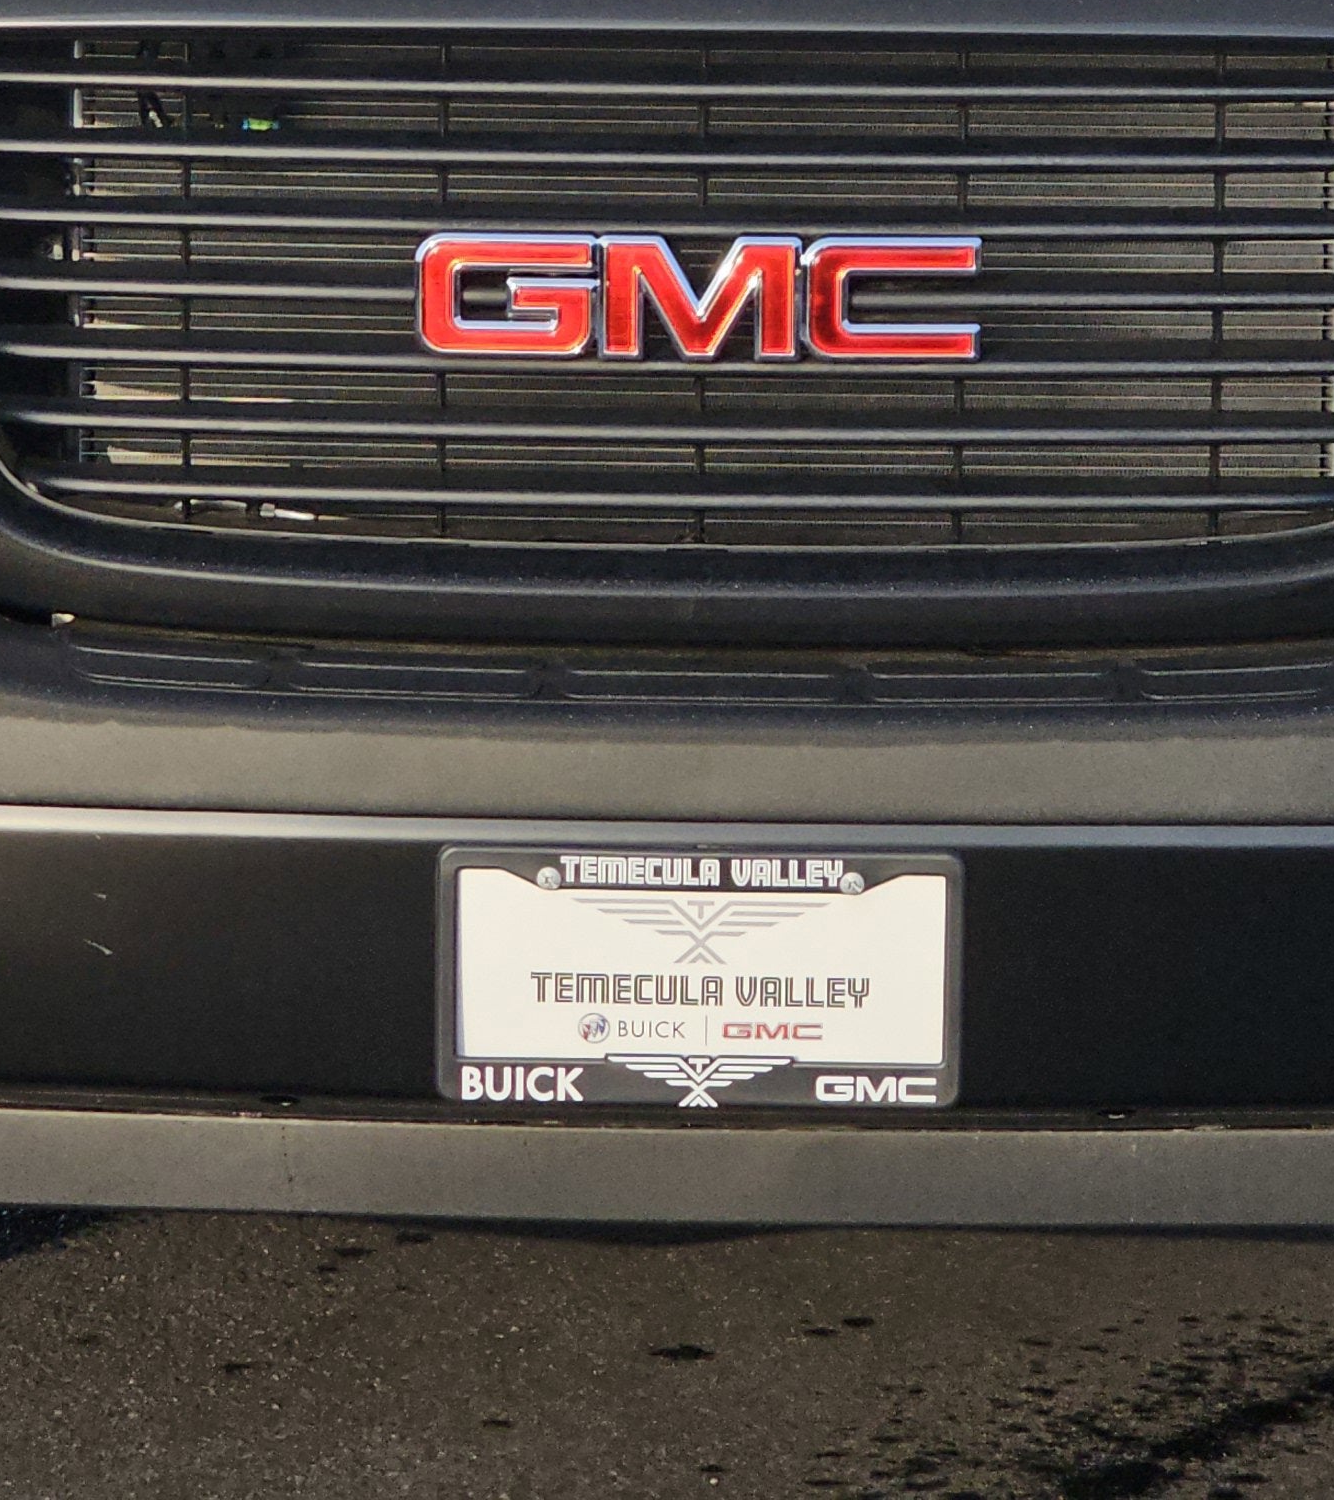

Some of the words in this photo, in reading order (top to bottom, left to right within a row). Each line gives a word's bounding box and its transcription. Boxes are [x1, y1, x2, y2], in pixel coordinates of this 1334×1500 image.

[415, 231, 982, 362] GMC
[560, 854, 721, 886] TEMECULA
[730, 859, 844, 888] VALLEY
[530, 971, 723, 1007] TEMECULA
[735, 976, 870, 1009] VALLEY
[617, 1020, 686, 1040] BUICK
[721, 1022, 824, 1041] GMC
[461, 1065, 584, 1102] BUICK
[815, 1075, 938, 1104] GMC
